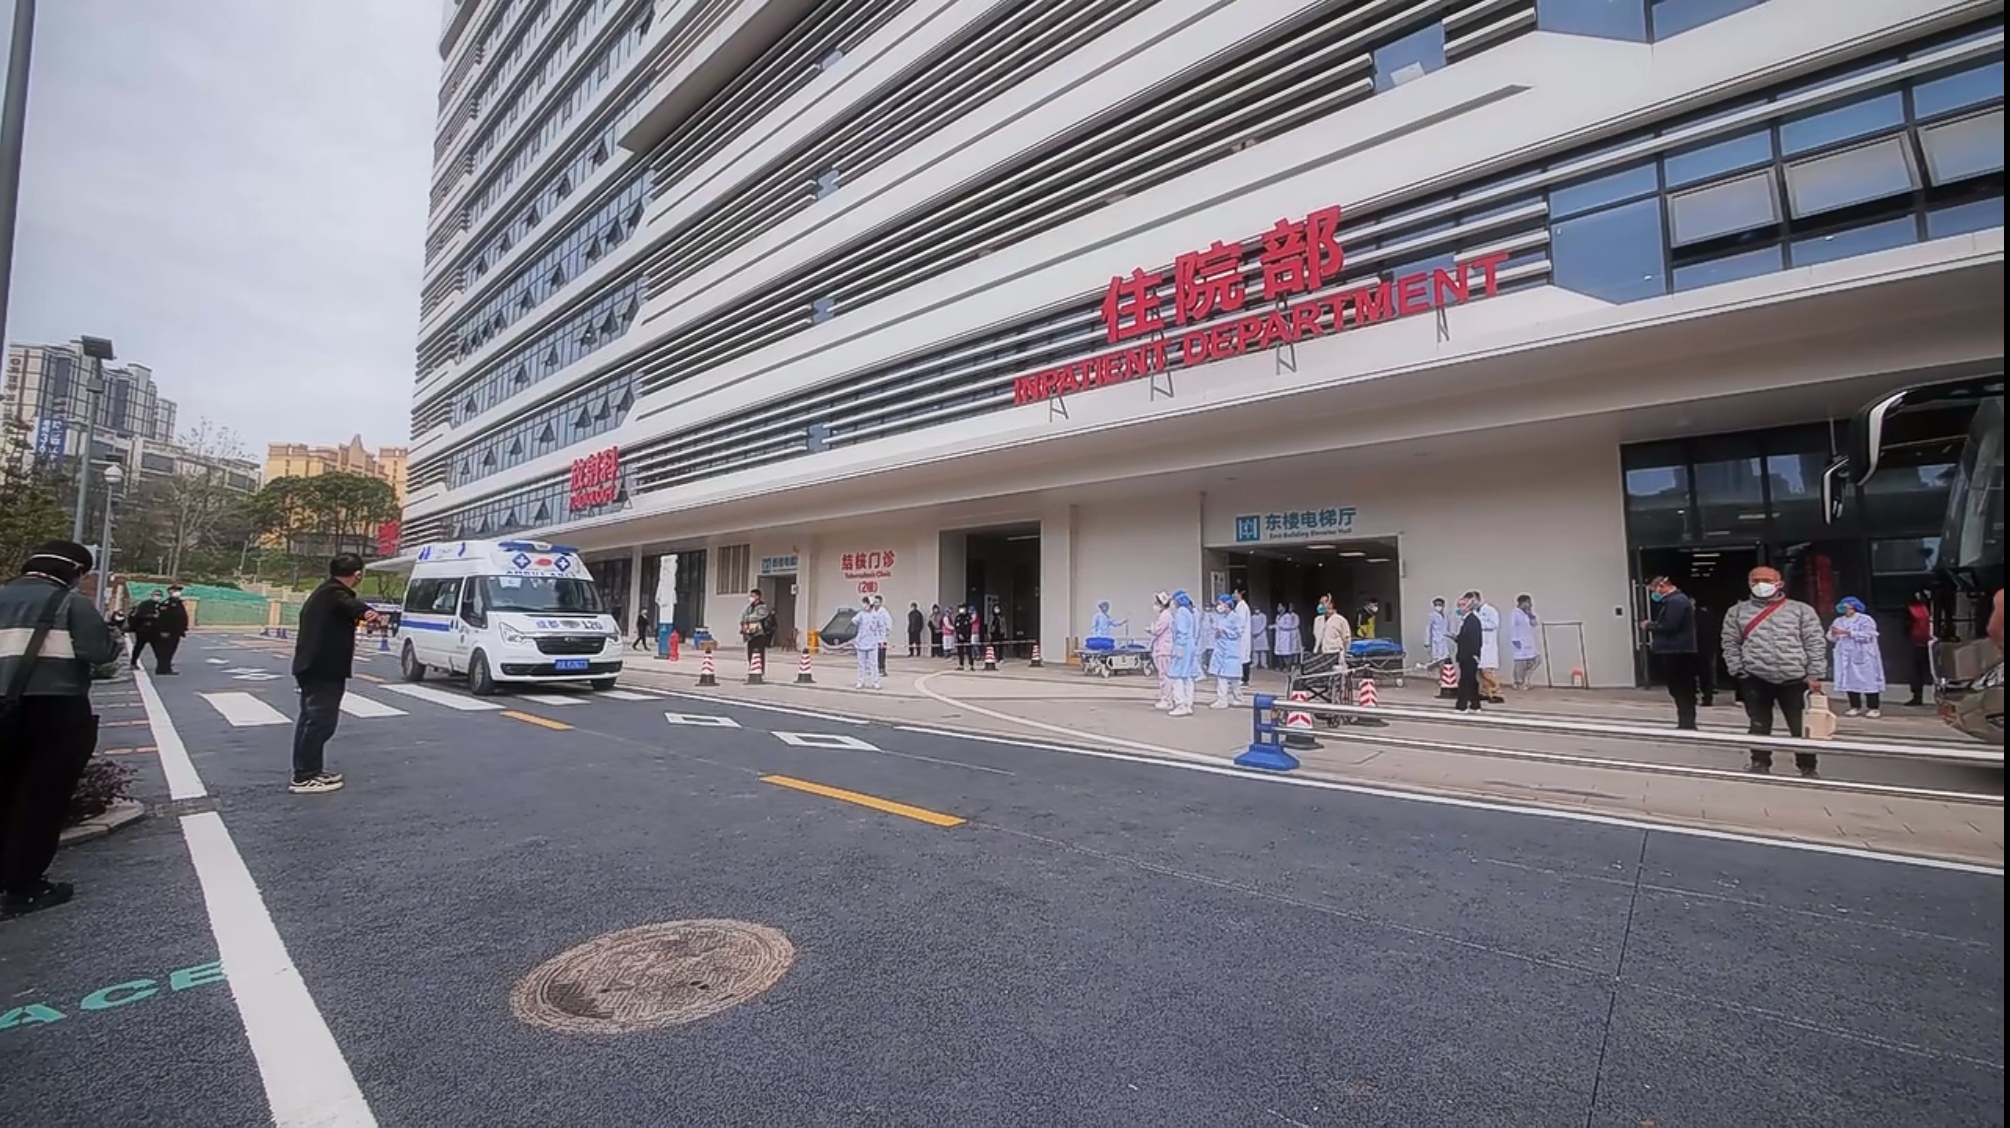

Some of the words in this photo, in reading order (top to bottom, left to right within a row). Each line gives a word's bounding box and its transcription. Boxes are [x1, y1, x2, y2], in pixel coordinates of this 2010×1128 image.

[1101, 205, 1345, 343] 住院部
[1013, 337, 1172, 406] INPATIENT
[1182, 251, 1509, 366] DEPARTMENT
[571, 446, 619, 490] 放射科
[1264, 507, 1356, 531] 东楼电梯厅
[1283, 530, 1309, 538] Building
[841, 550, 895, 570] 结核门诊
[581, 620, 603, 630] 120
[0, 960, 227, 1029] ACE
